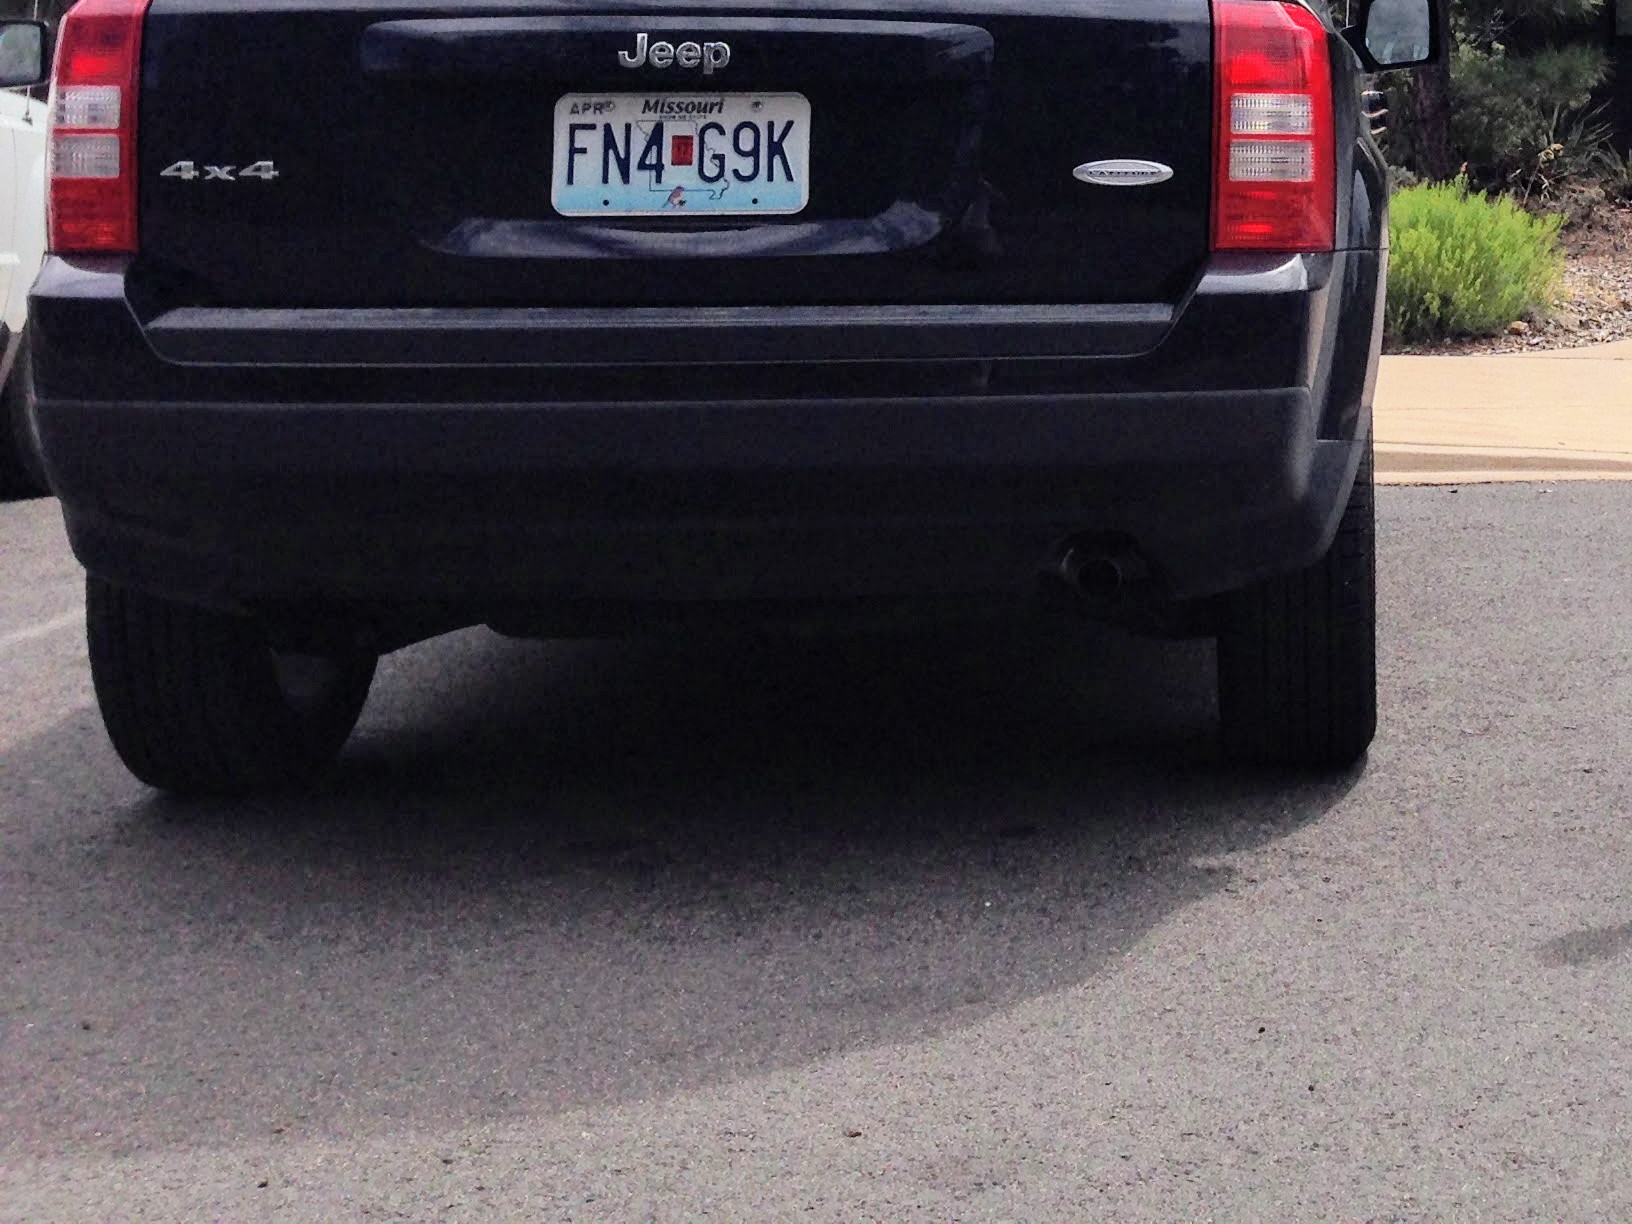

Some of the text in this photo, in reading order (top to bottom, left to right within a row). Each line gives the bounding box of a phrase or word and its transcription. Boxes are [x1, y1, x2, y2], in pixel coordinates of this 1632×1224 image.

[617, 32, 731, 74] Jeep
[569, 101, 604, 115] APR
[641, 98, 726, 114] Missouri
[565, 120, 795, 187] FN4 G9K
[159, 160, 280, 181] 4x4
